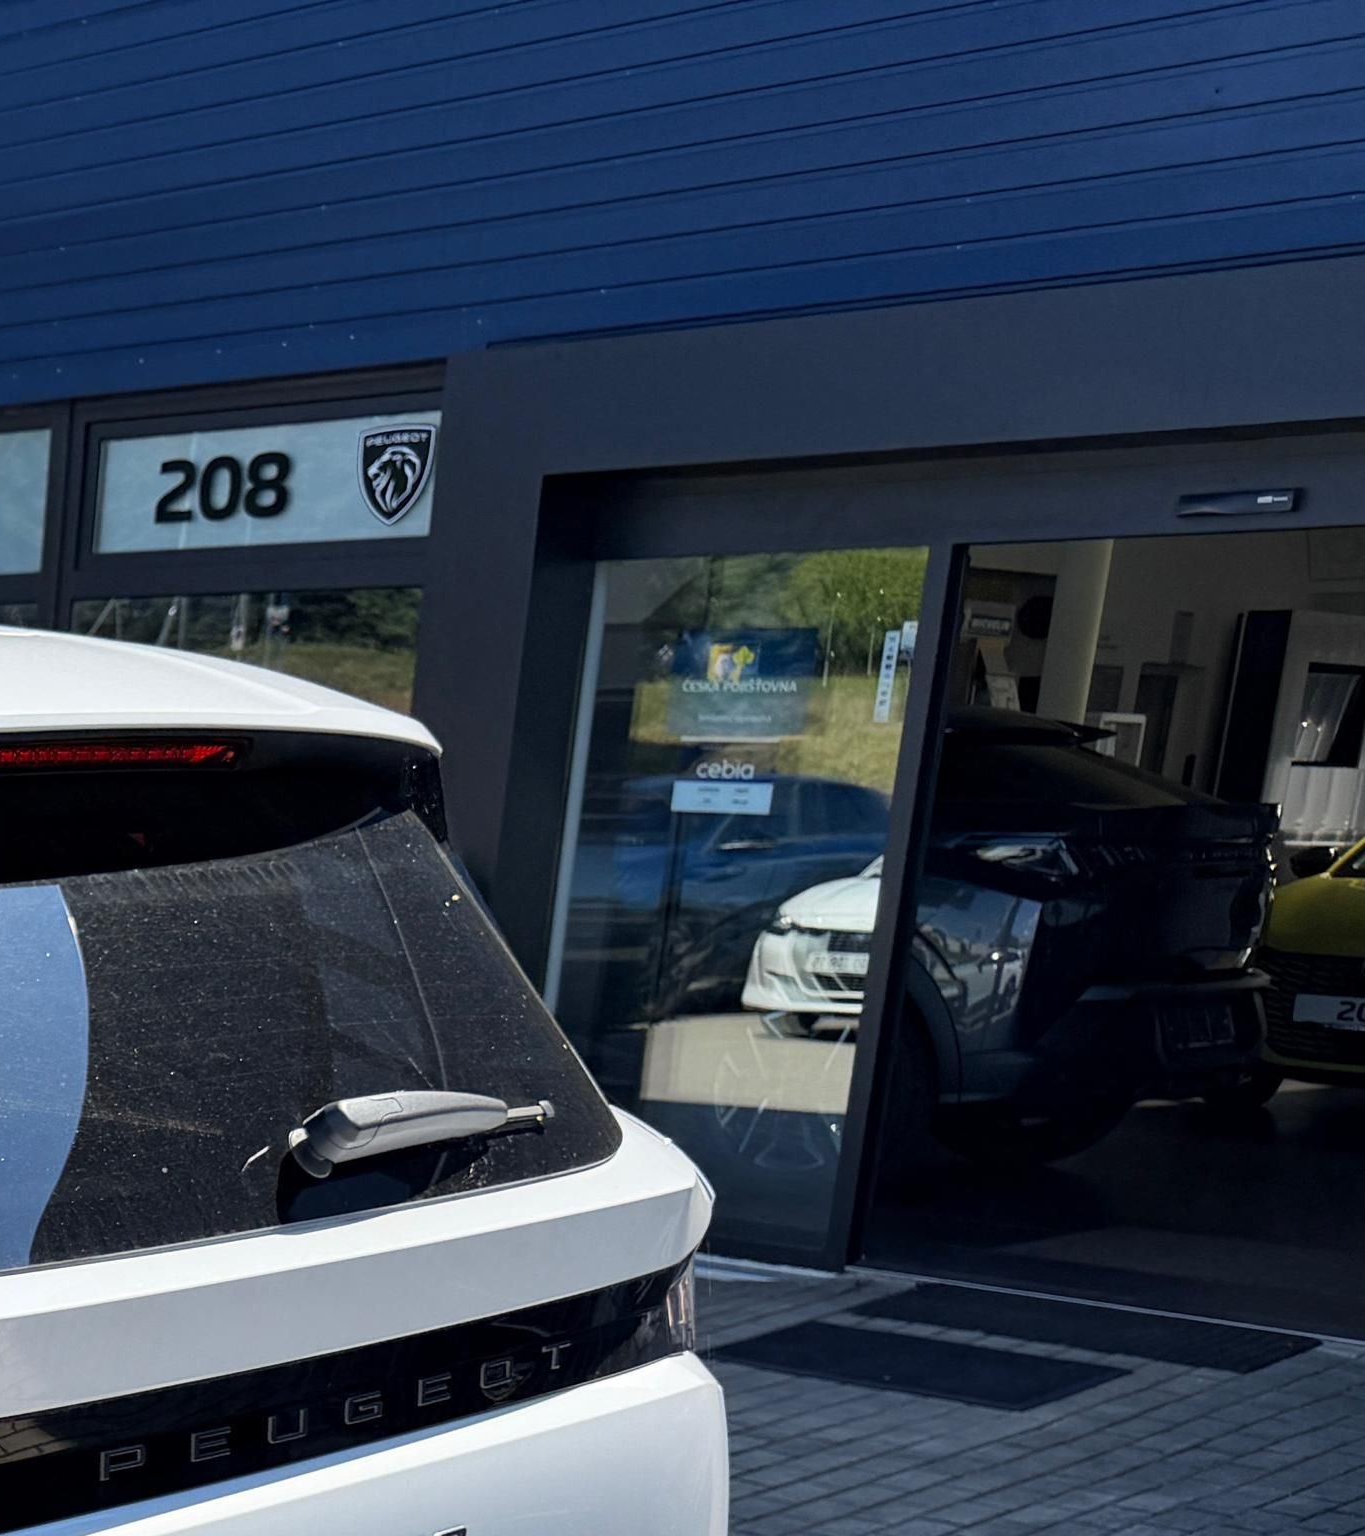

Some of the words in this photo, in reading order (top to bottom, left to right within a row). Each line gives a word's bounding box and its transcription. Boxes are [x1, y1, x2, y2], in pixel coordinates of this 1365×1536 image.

[154, 452, 292, 525] 208
[695, 759, 755, 780] cebia
[98, 1341, 573, 1482] PEUGEOT
